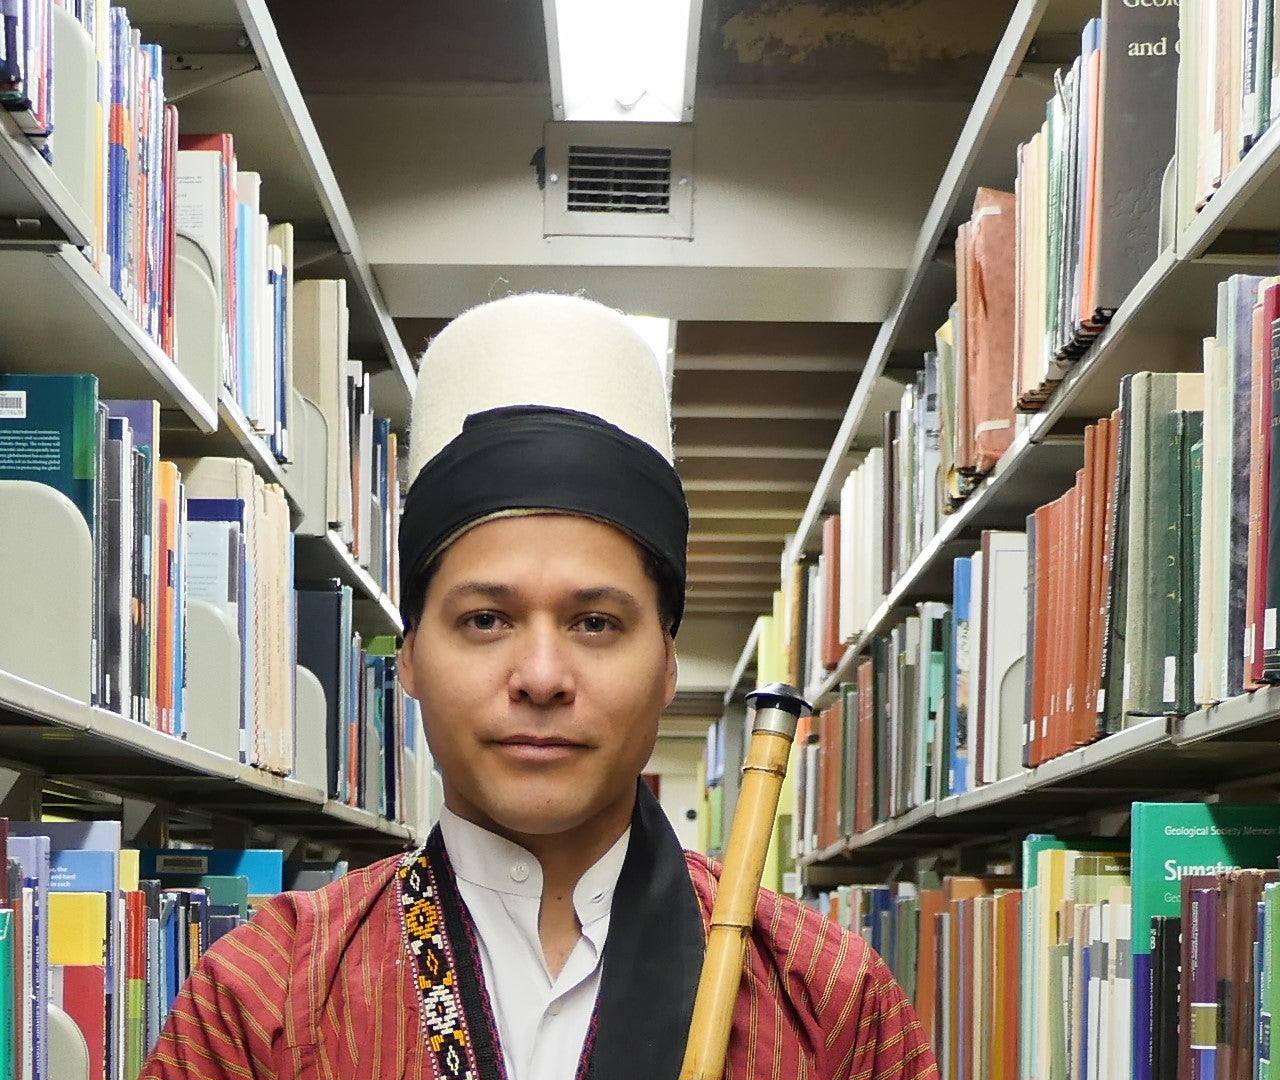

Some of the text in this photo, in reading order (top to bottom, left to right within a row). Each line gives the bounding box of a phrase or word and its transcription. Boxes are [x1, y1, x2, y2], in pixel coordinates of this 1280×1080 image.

[1128, 37, 1167, 56] and
[1164, 826, 1209, 838] Geological
[1211, 826, 1241, 838] Society
